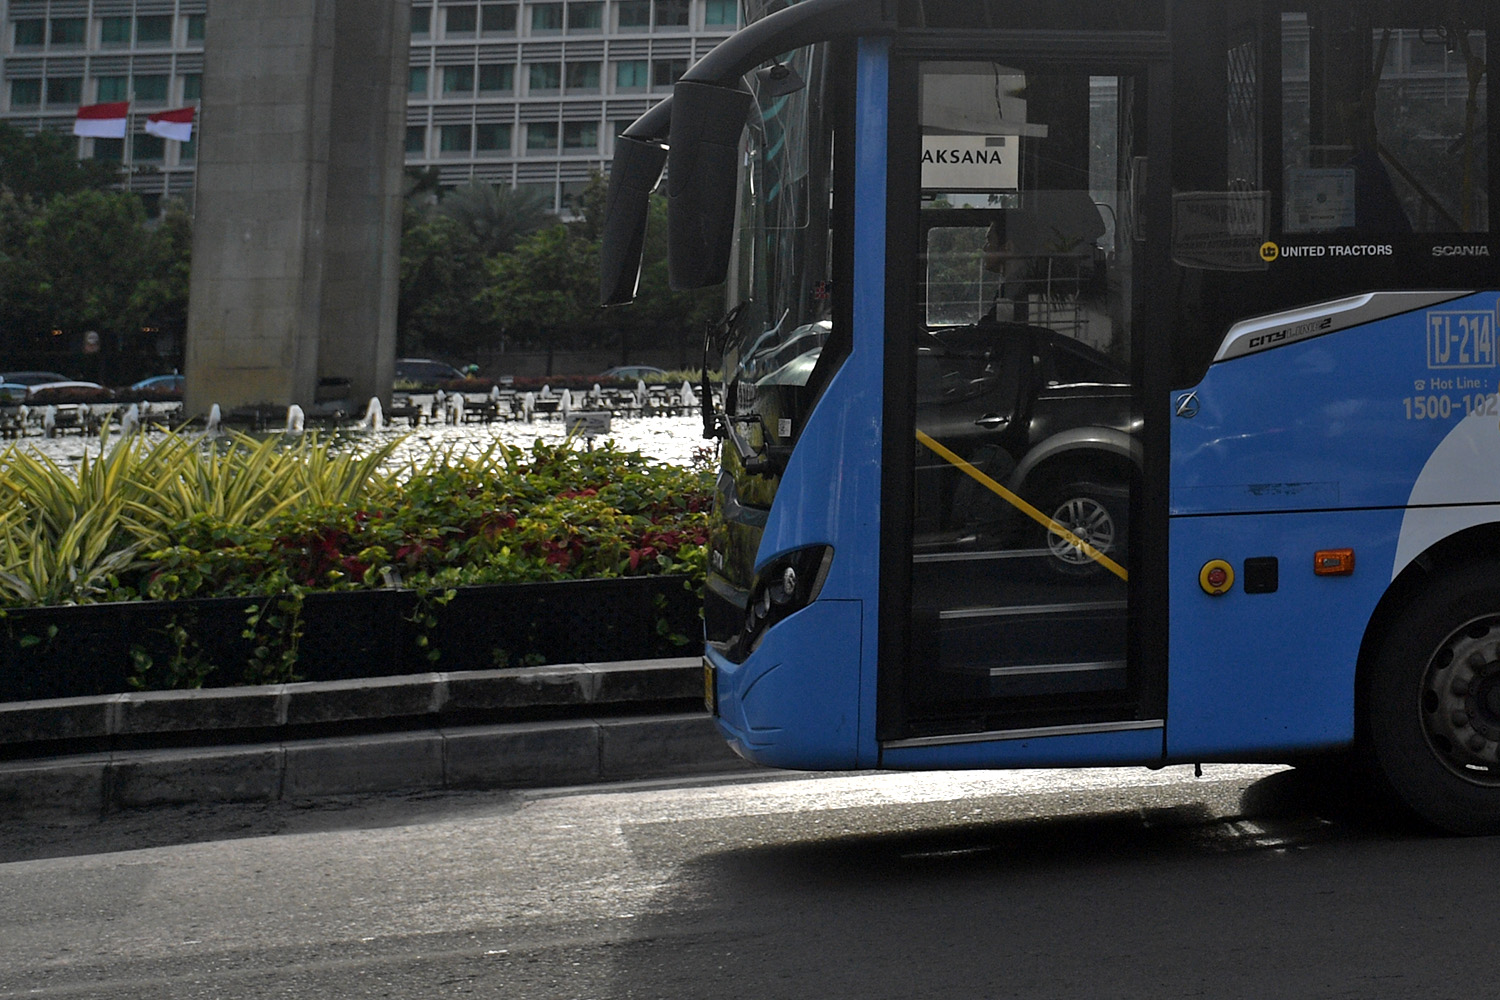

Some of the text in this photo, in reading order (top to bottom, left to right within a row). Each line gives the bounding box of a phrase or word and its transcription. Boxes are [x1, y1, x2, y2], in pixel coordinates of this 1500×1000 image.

[921, 149, 1002, 165] AKSANA
[1281, 245, 1393, 258] UNITED TRACTORS
[1432, 245, 1490, 257] SCANIA
[1431, 316, 1491, 364] TJ-214
[1430, 377, 1453, 390] Hot
[1456, 375, 1481, 389] Line
[1403, 393, 1499, 420] 1500-102
